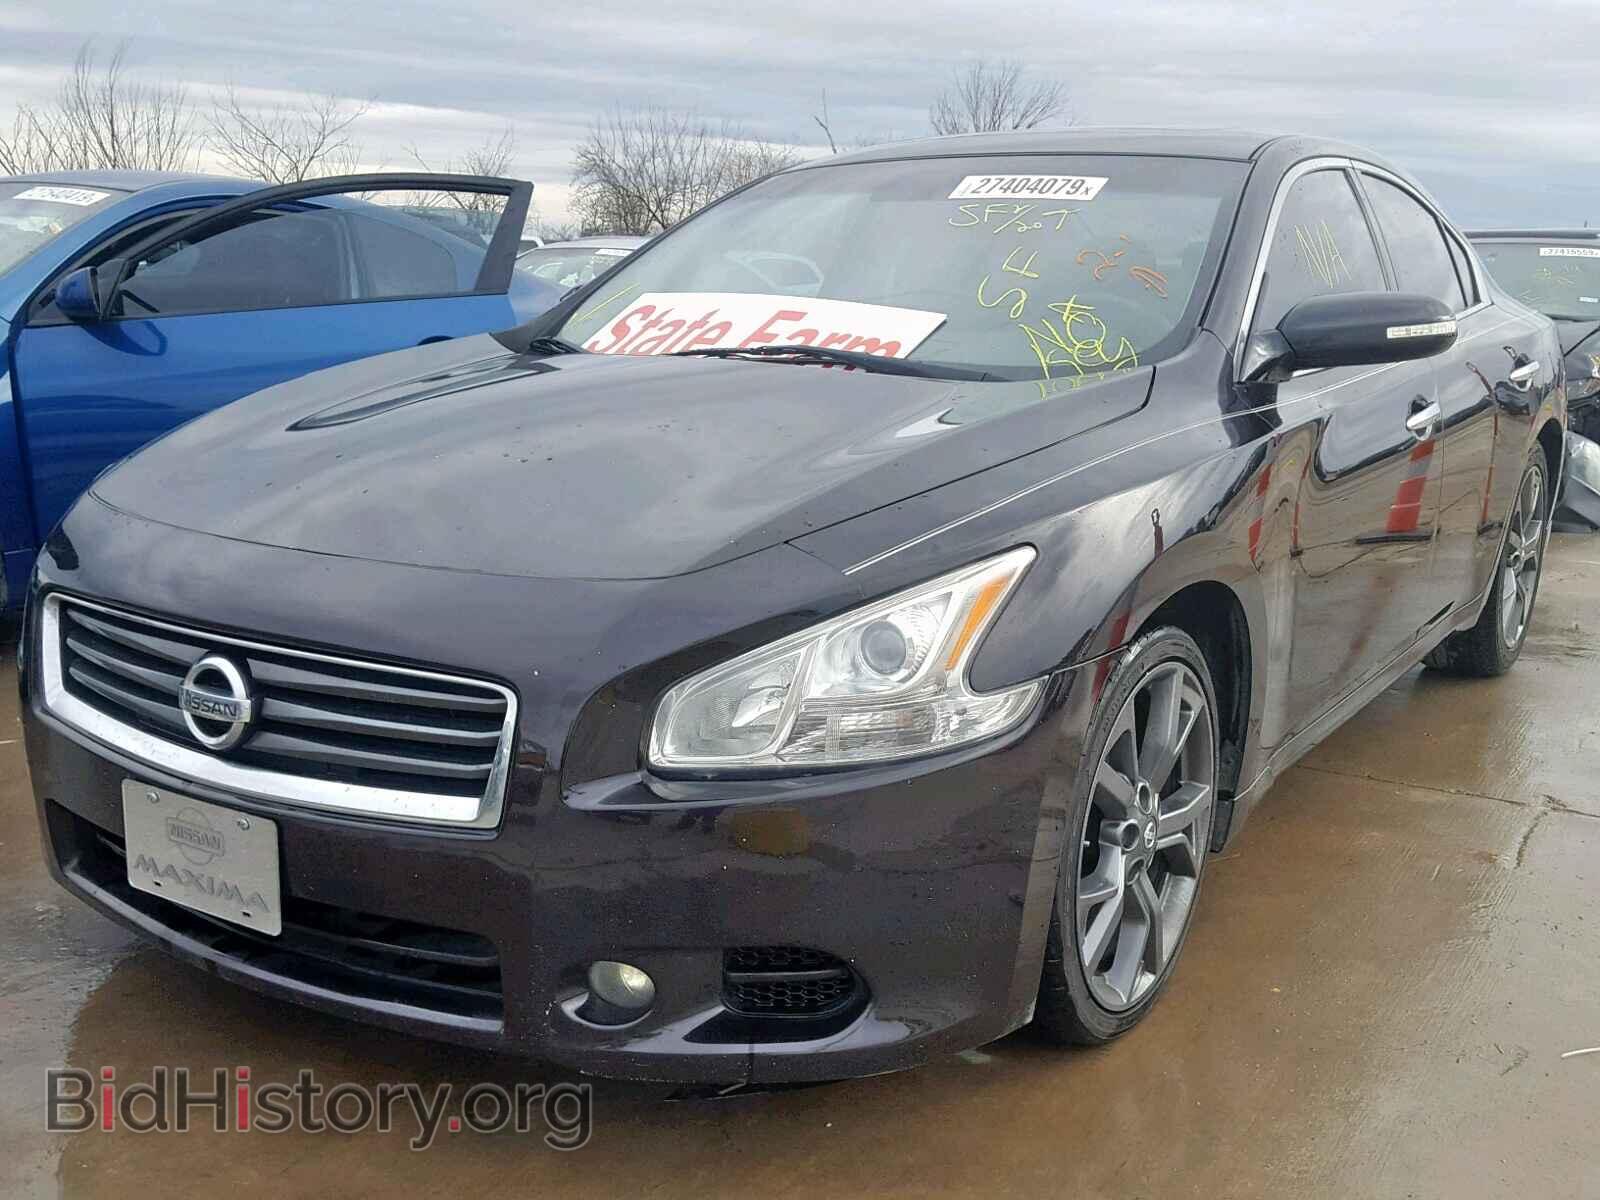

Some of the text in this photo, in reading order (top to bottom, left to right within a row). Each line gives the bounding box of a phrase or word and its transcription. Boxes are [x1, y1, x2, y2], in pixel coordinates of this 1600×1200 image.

[587, 304, 732, 356] State
[182, 687, 238, 718] NISSAN
[169, 822, 222, 850] NISSAN
[133, 852, 271, 913] MAXIMA
